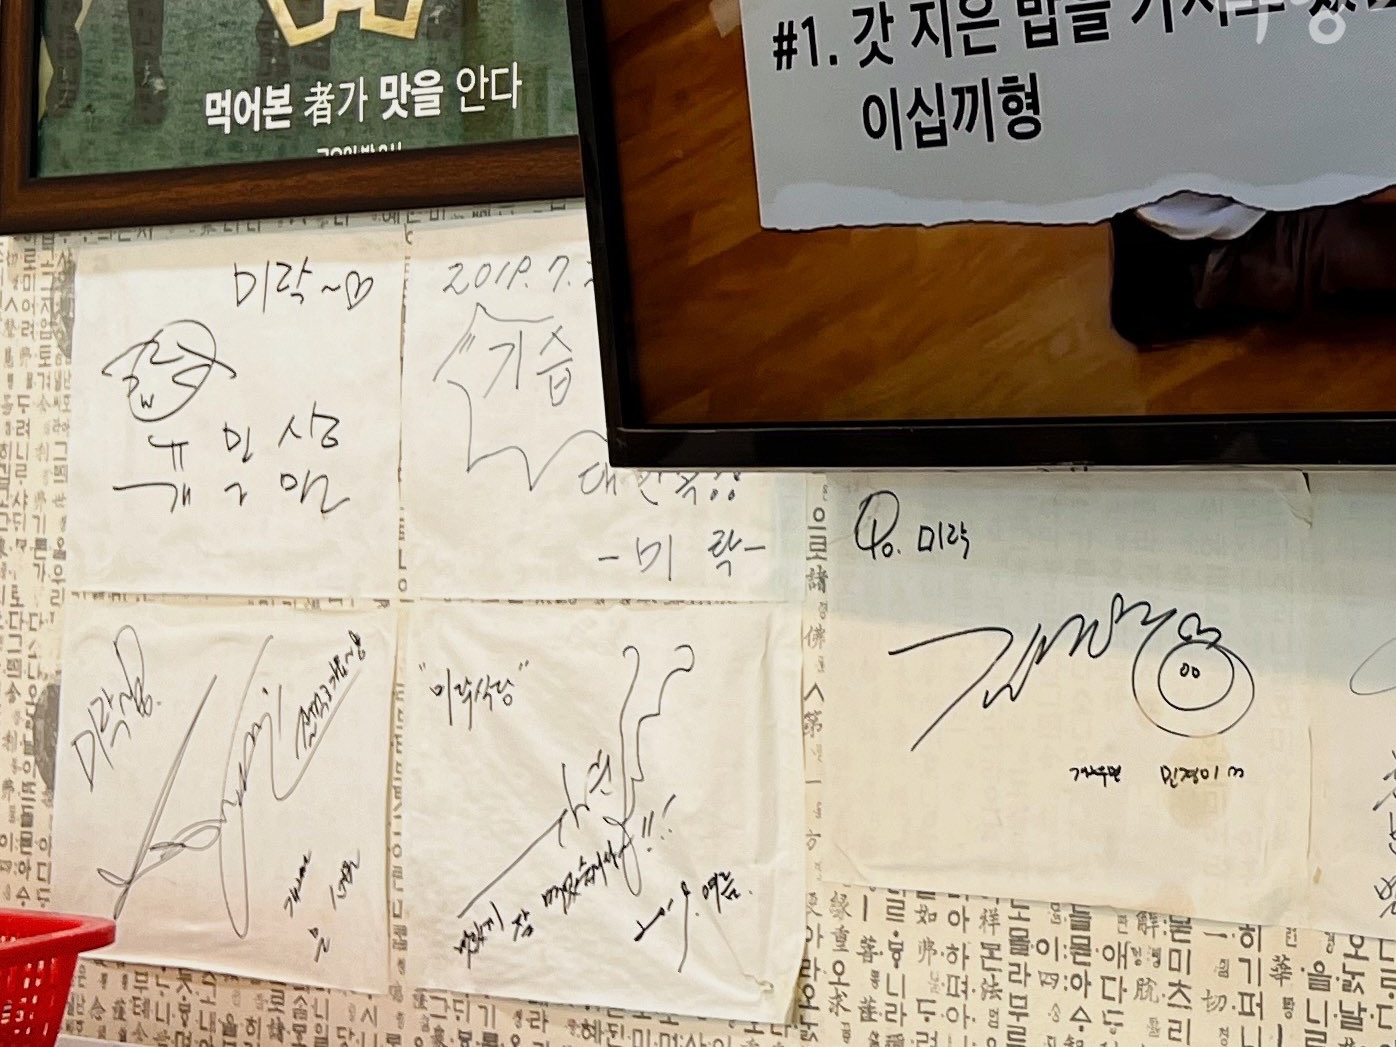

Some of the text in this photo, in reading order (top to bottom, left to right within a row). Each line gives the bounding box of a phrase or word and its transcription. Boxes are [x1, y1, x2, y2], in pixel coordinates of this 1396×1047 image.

[771, 15, 838, 72] #1.
[852, 0, 896, 69] 갓
[205, 83, 293, 134] 먹어본
[380, 69, 444, 120] 맛을
[455, 61, 523, 113] 안다
[861, 71, 1044, 151] 이십끼형
